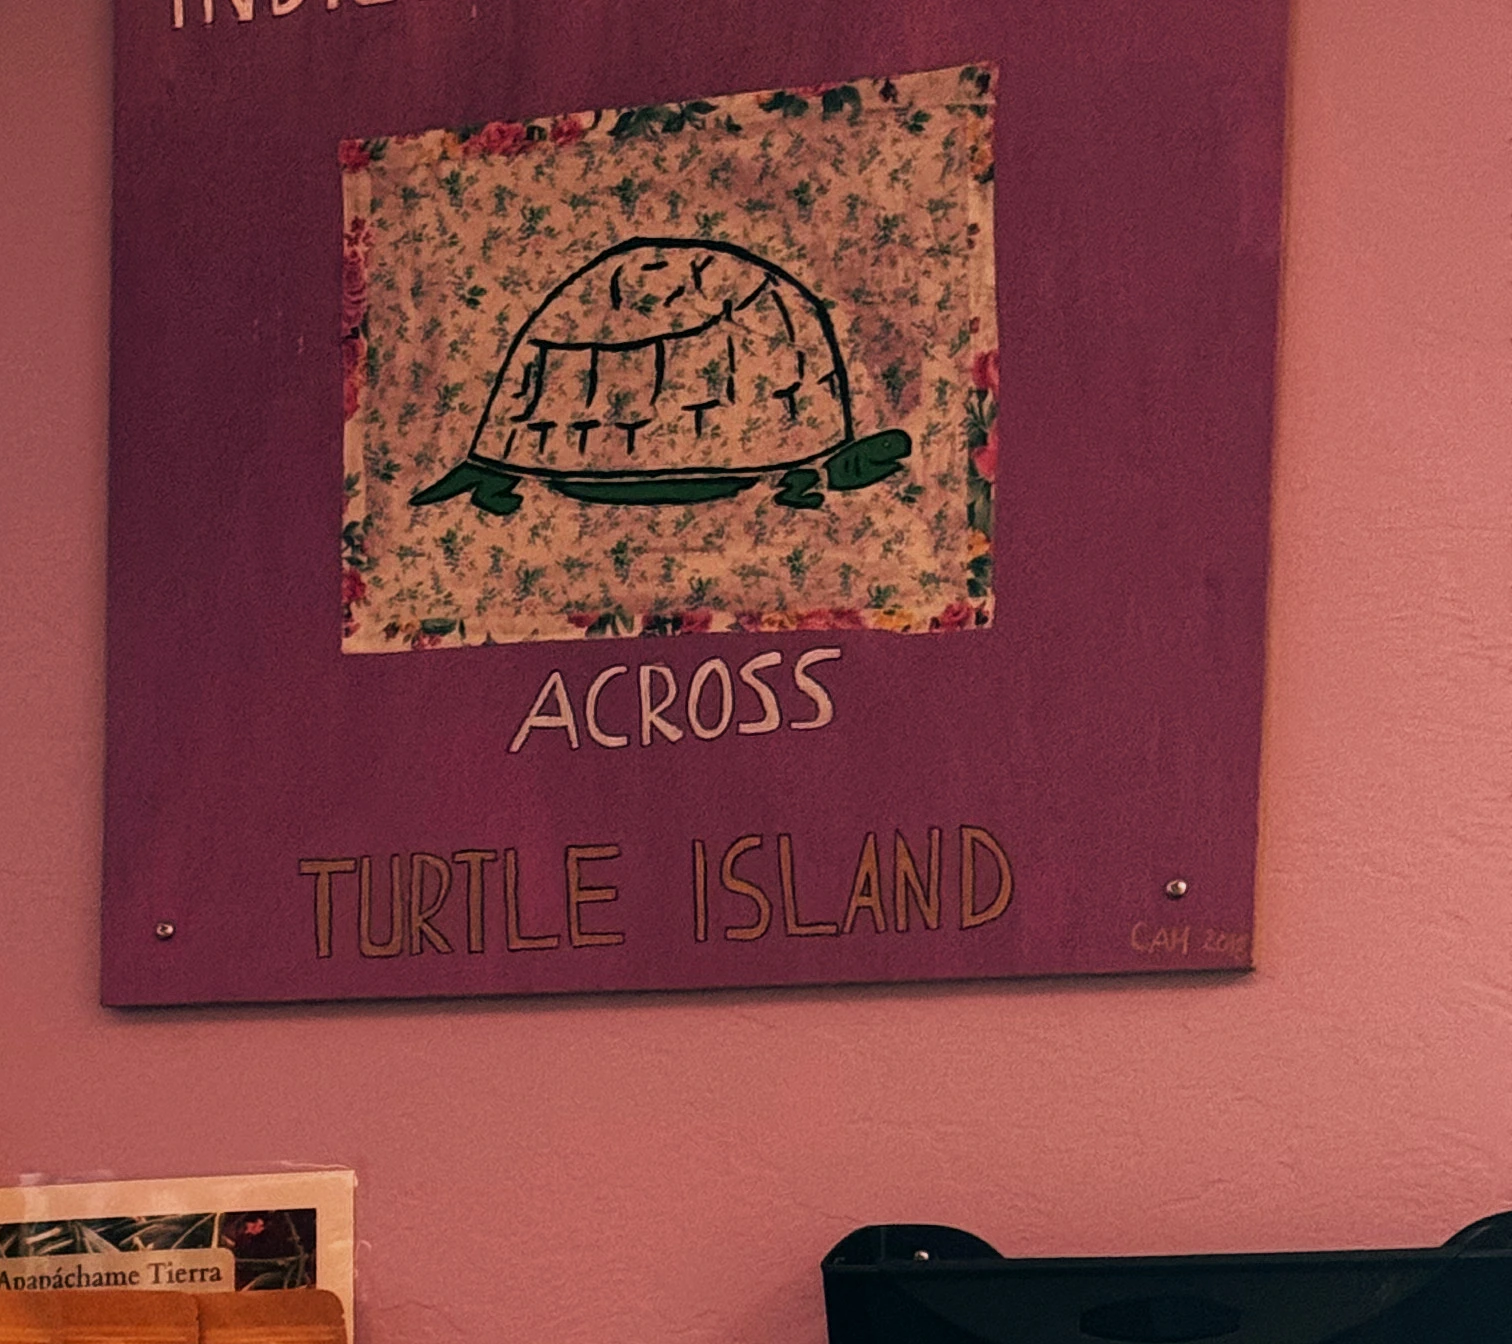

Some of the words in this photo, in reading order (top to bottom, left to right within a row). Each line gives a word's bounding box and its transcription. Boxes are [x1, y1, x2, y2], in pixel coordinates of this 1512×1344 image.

[508, 649, 841, 753] ACROSS
[298, 844, 627, 960] TURTLE
[692, 826, 1015, 943] ISLAND
[148, 1261, 223, 1286] Tierra
